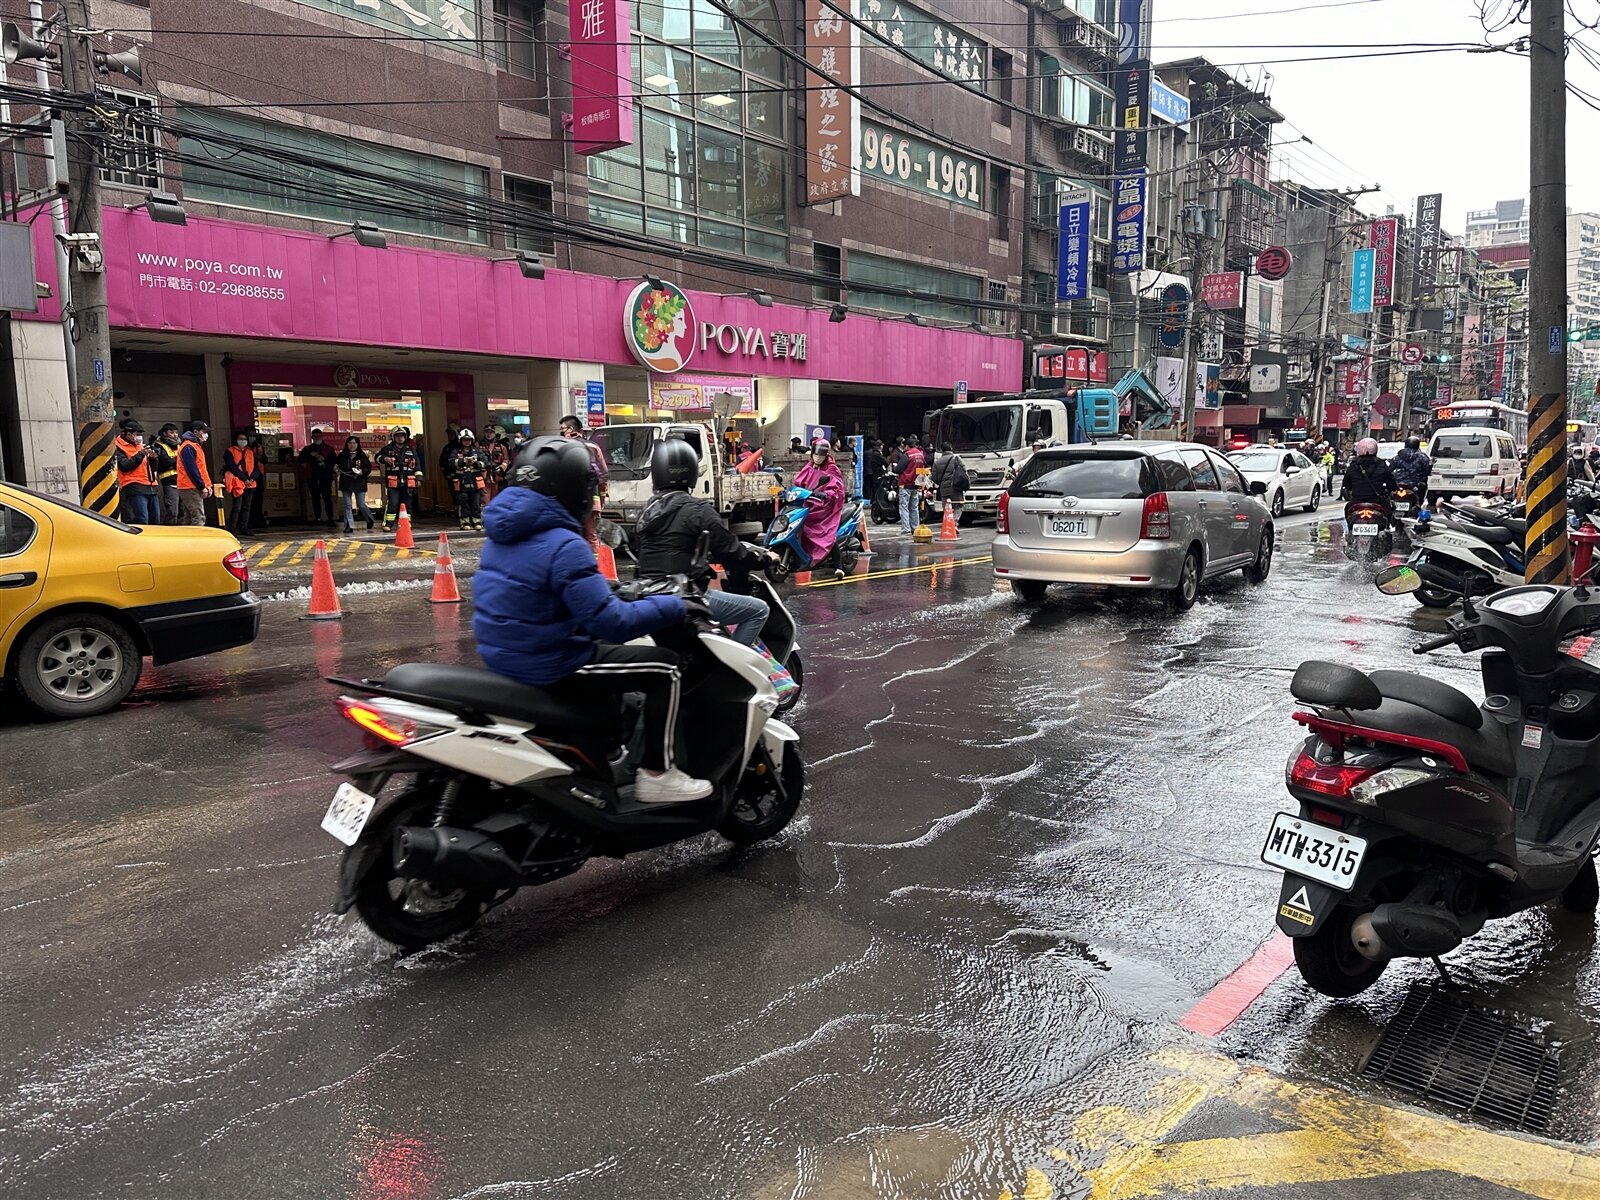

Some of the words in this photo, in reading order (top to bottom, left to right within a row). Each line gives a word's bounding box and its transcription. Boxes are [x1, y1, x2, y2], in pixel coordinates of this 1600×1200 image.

[858, 127, 979, 202] 966-1961
[1062, 192, 1087, 201] HITACHI
[1421, 196, 1436, 248] 旅居文旅
[1066, 207, 1081, 296] 日立變頻冷氣
[1113, 253, 1142, 269] 電視
[137, 252, 283, 279] www.poya.com.tw
[139, 273, 285, 300] 門市電話:02-29688555
[700, 321, 768, 357] POYA
[770, 331, 807, 360] 寶雅
[361, 374, 391, 385] POYA
[1437, 408, 1453, 420] 843
[1269, 826, 1360, 876] MTW-3315
